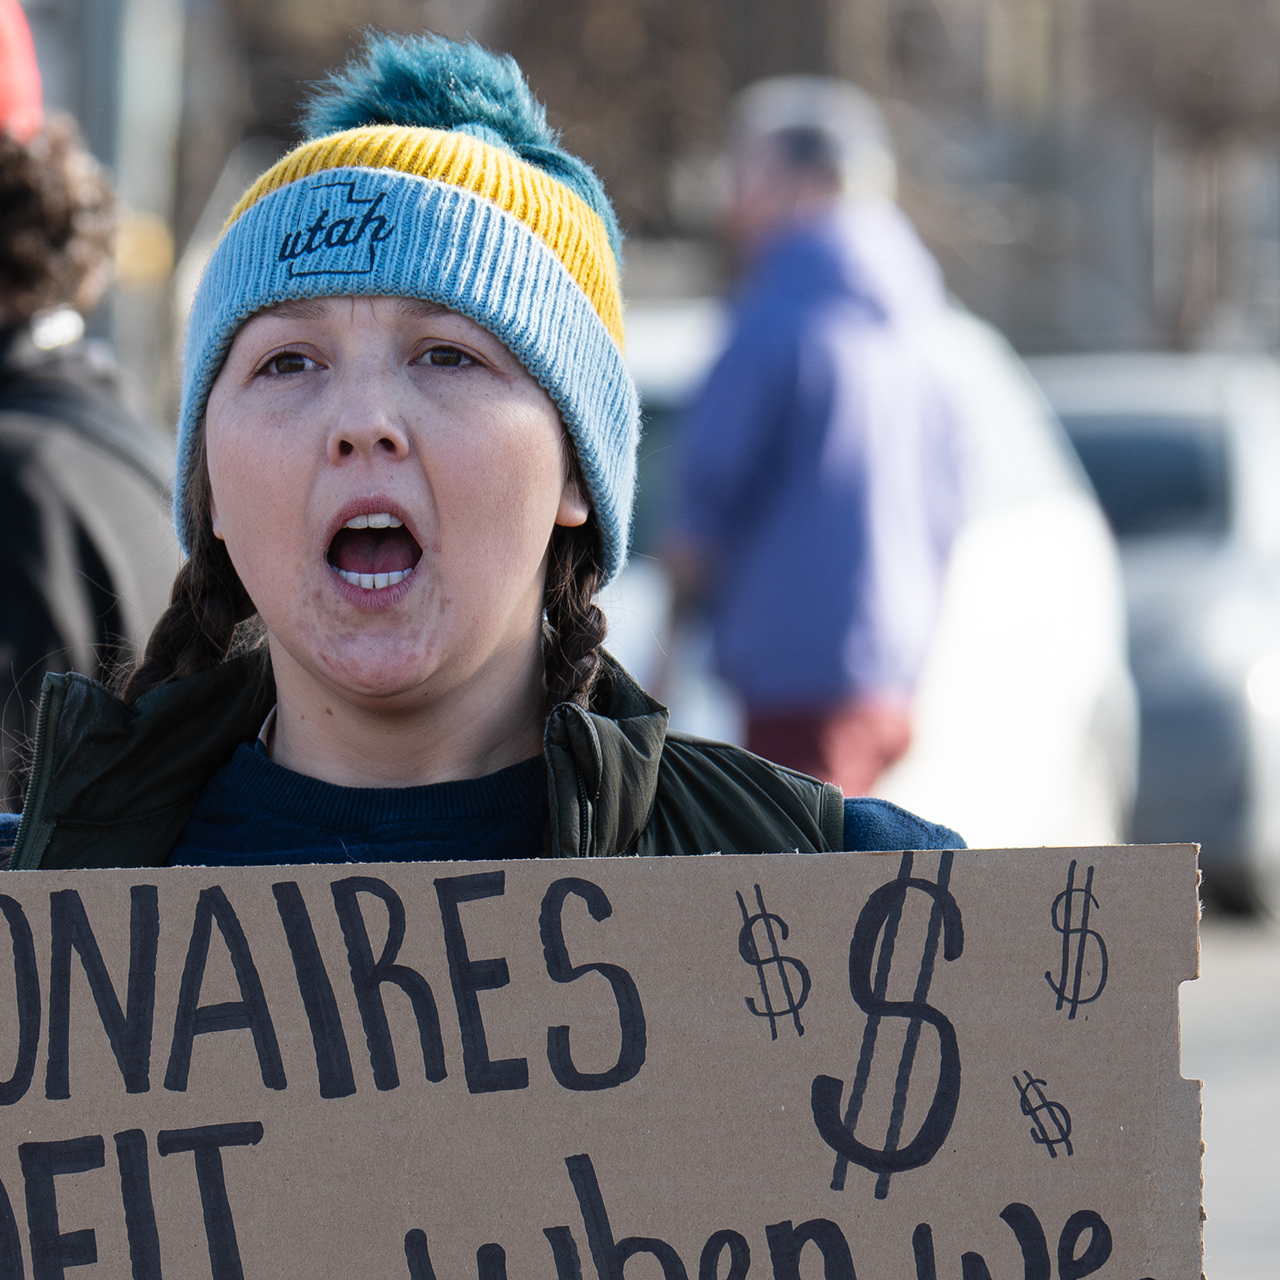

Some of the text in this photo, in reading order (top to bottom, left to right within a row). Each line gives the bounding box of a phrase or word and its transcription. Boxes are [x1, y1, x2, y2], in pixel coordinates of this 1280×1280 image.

[278, 192, 395, 262] utah
[735, 882, 812, 1042] $
[809, 850, 965, 1200] $
[1044, 859, 1109, 1020] $
